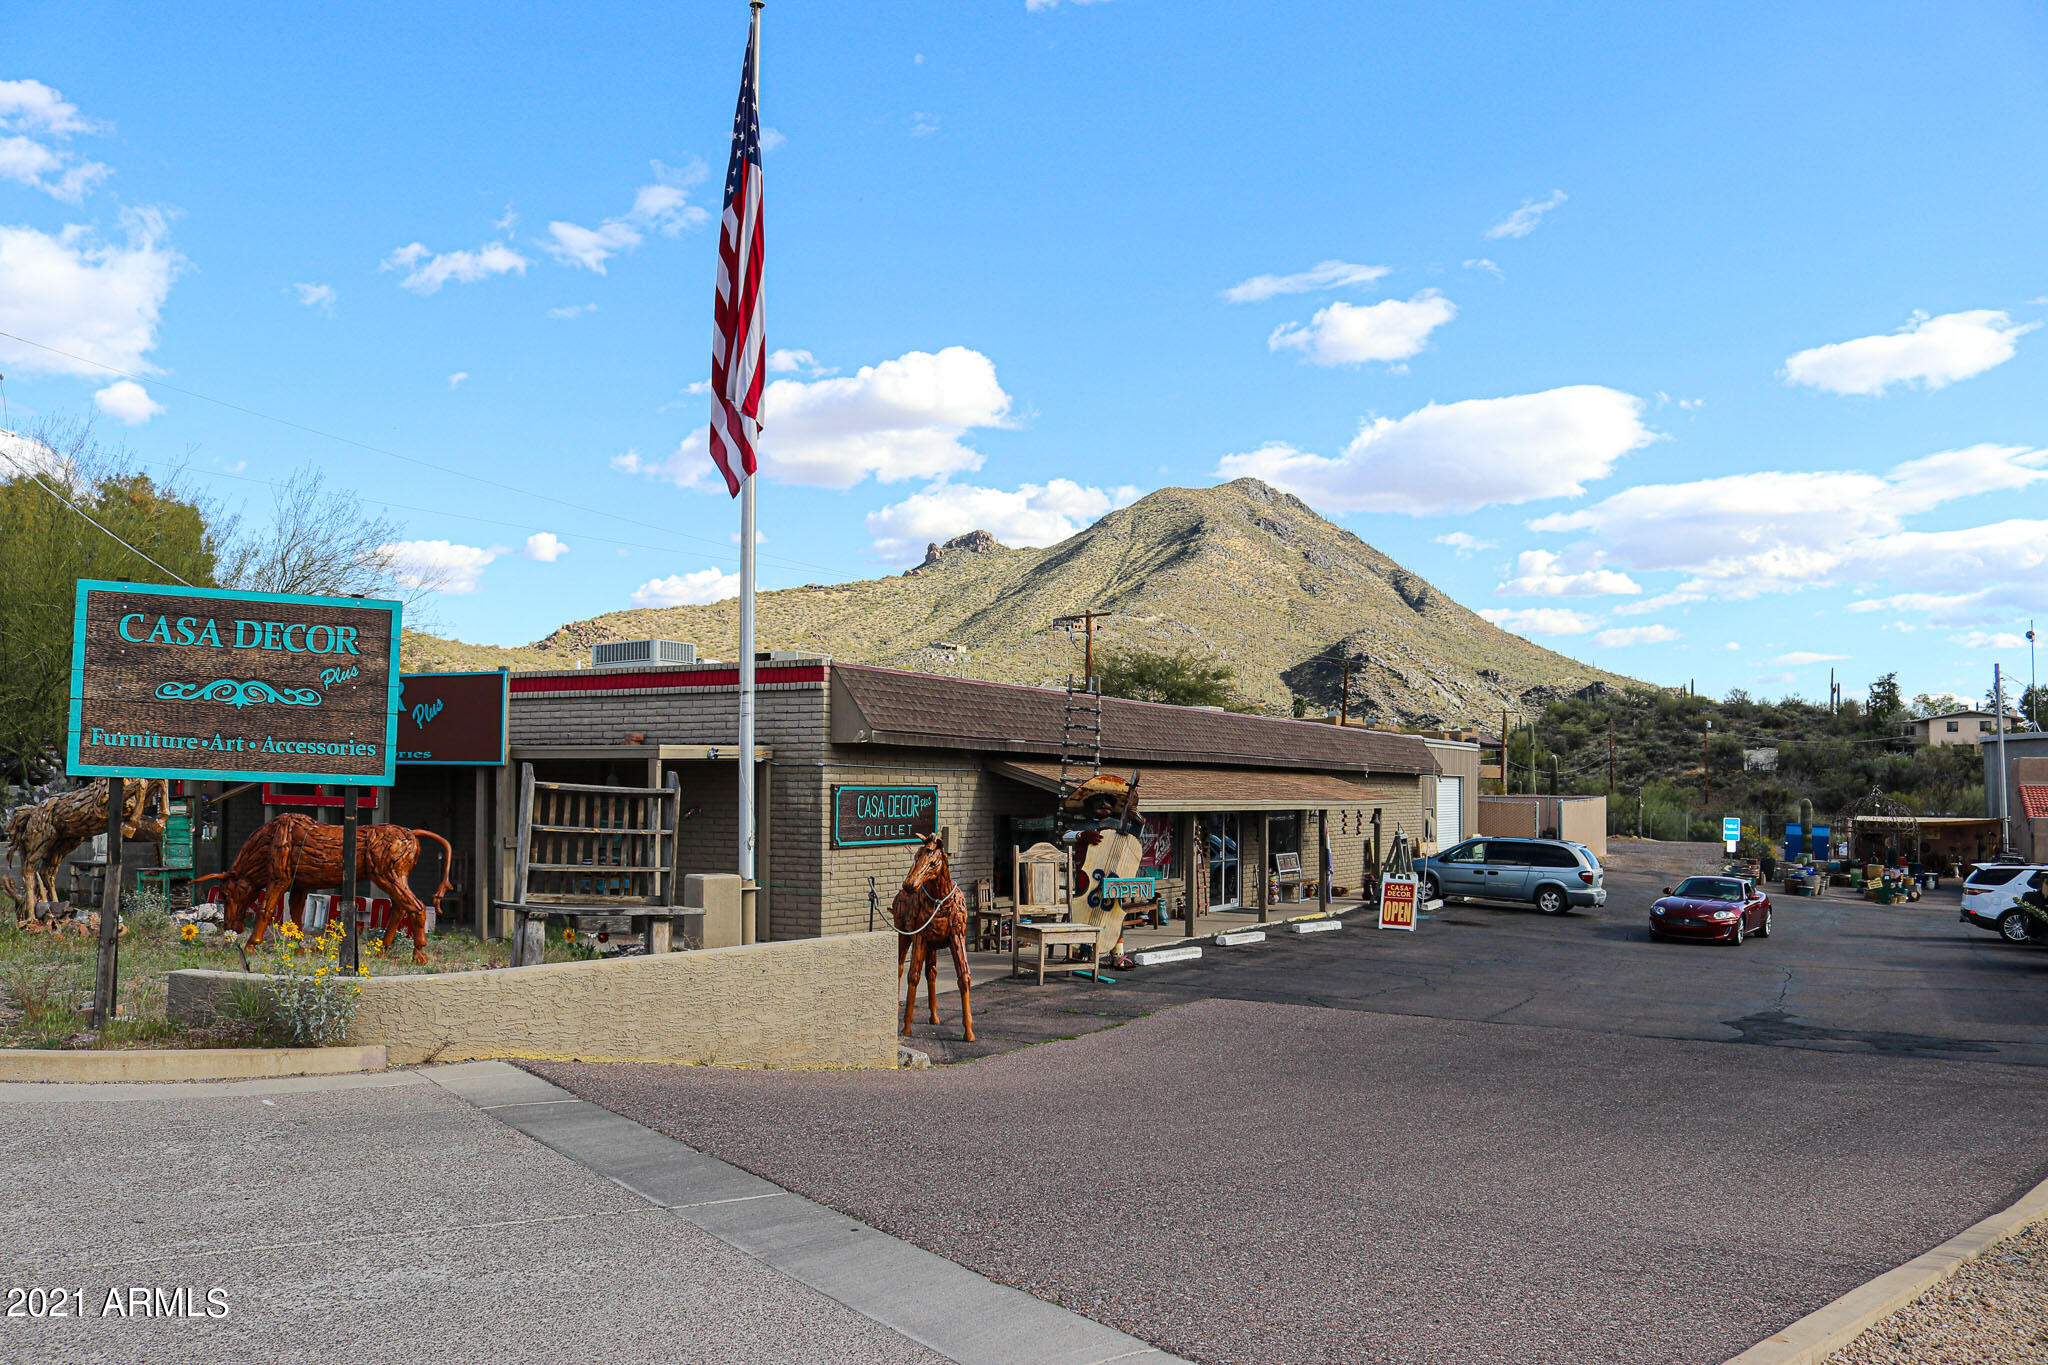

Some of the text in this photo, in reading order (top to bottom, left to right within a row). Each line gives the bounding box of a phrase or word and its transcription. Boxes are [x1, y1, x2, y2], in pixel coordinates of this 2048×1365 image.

[118, 613, 361, 655] CASA DECOR
[320, 664, 360, 691] Plus
[412, 698, 444, 729] Plus
[90, 727, 376, 758] Furniture Art Accessories
[857, 794, 885, 818] CASA
[887, 793, 920, 818] DECOR
[864, 824, 912, 837] OUTLET
[1109, 884, 1150, 898] OPEN
[1384, 901, 1411, 922] OPEN
